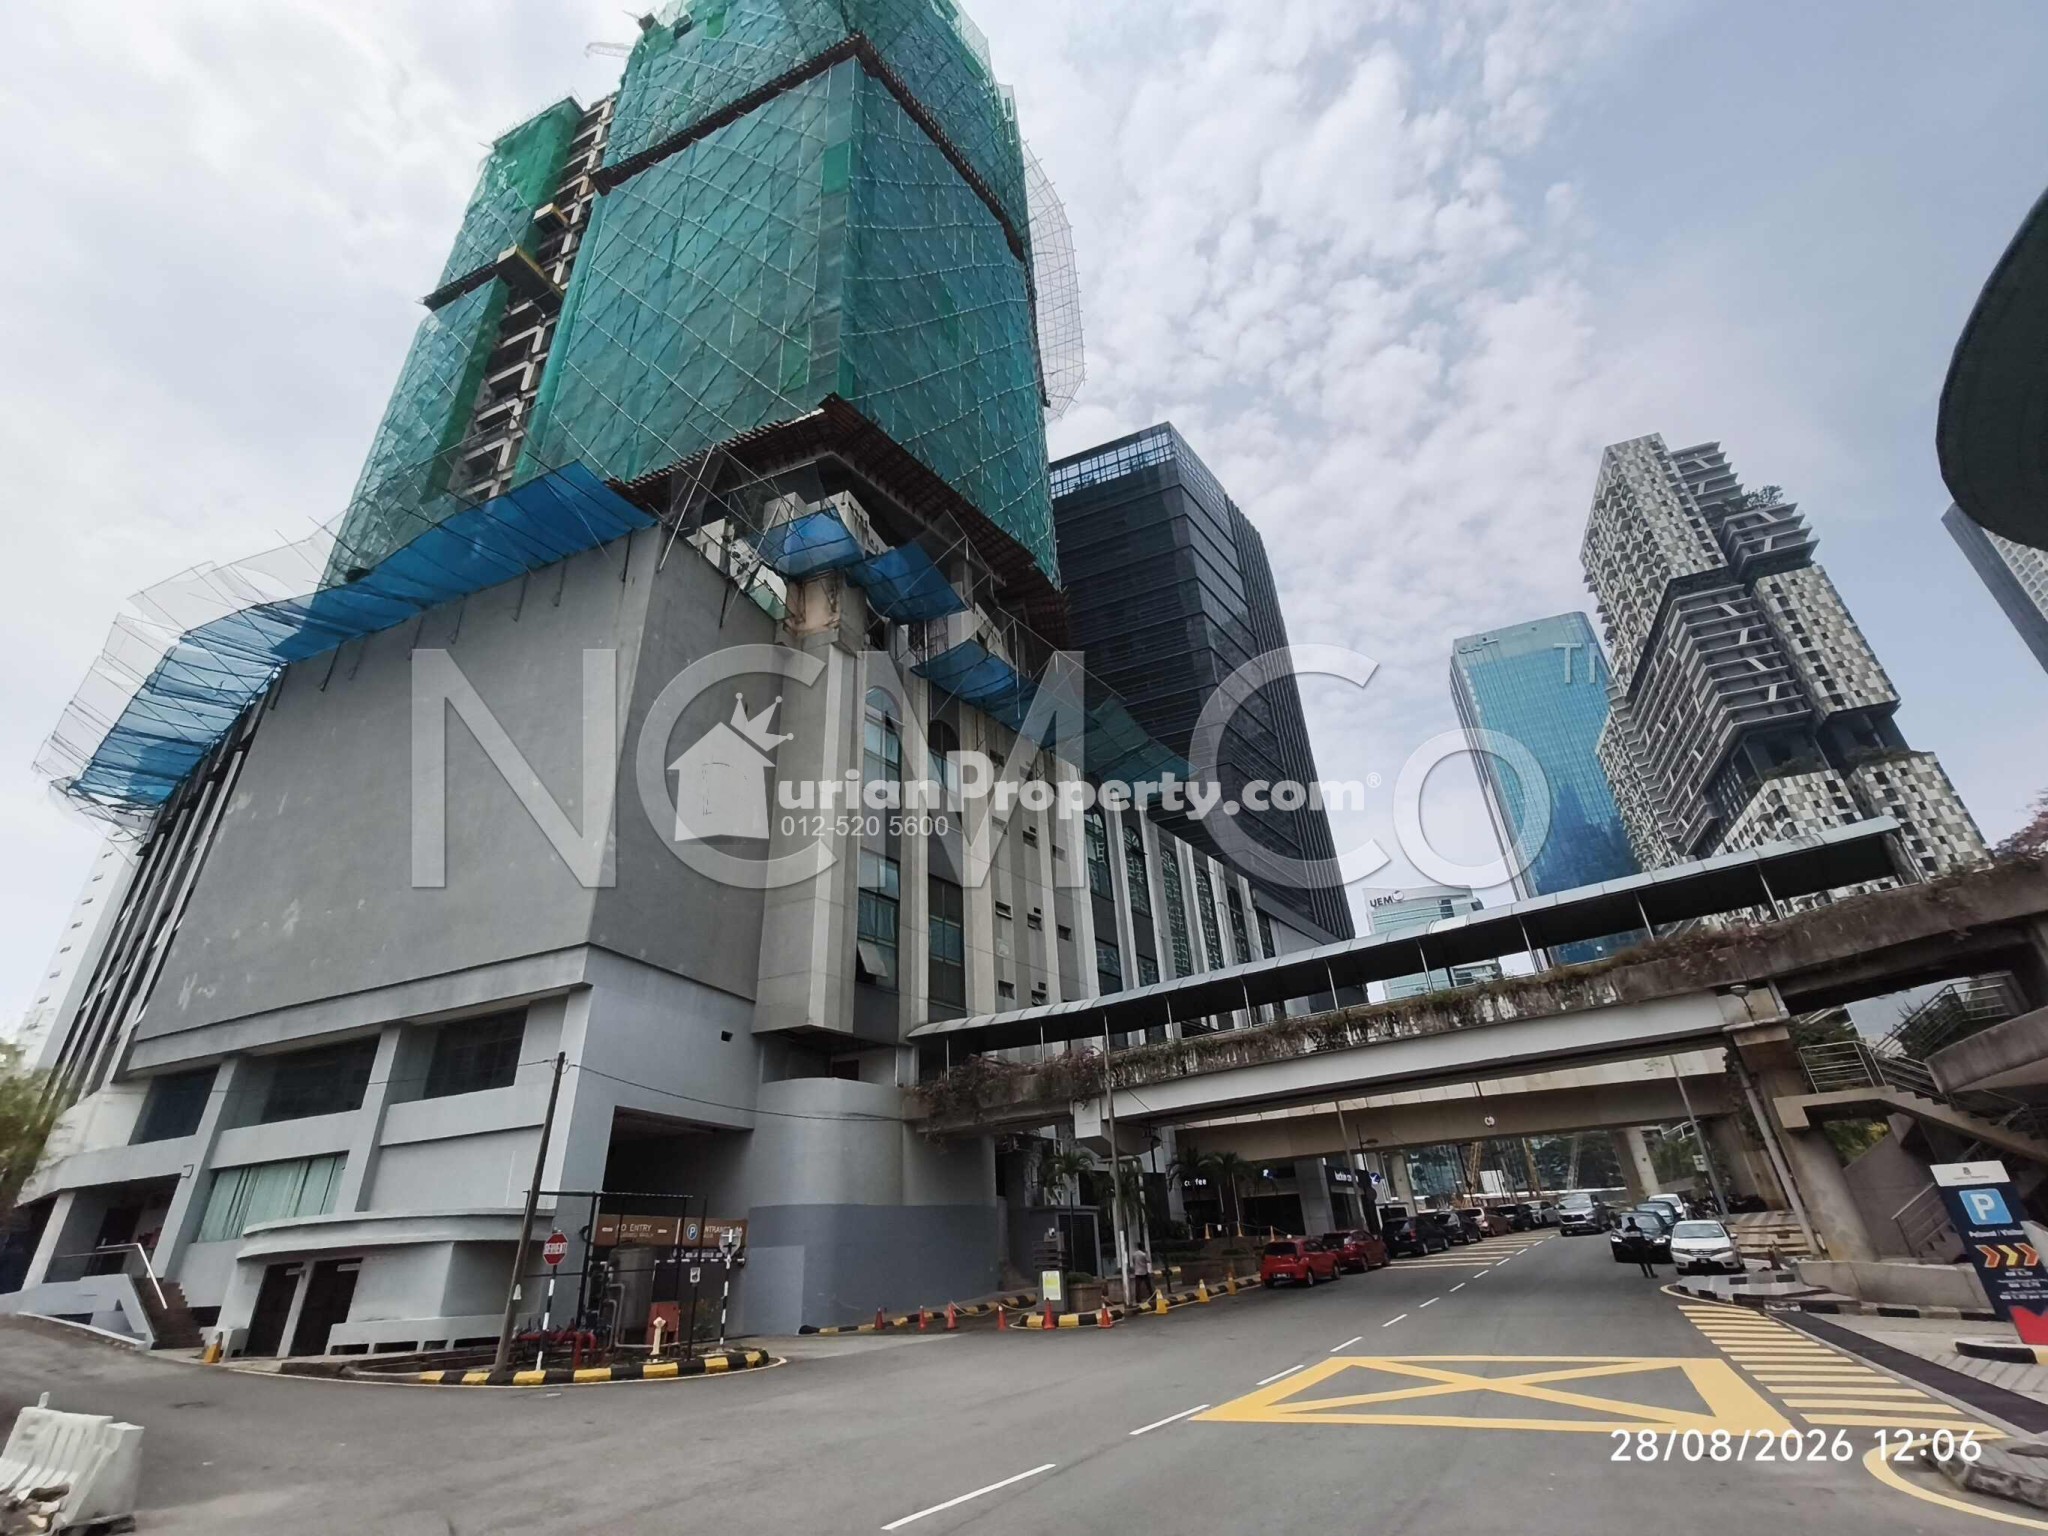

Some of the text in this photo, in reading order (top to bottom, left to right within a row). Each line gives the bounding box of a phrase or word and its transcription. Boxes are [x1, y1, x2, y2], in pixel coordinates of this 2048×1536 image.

[1369, 895, 1393, 908] UEM
[1184, 1178, 1207, 1187] cofee
[1969, 1193, 1995, 1221] P
[629, 1223, 652, 1232] ENTRY
